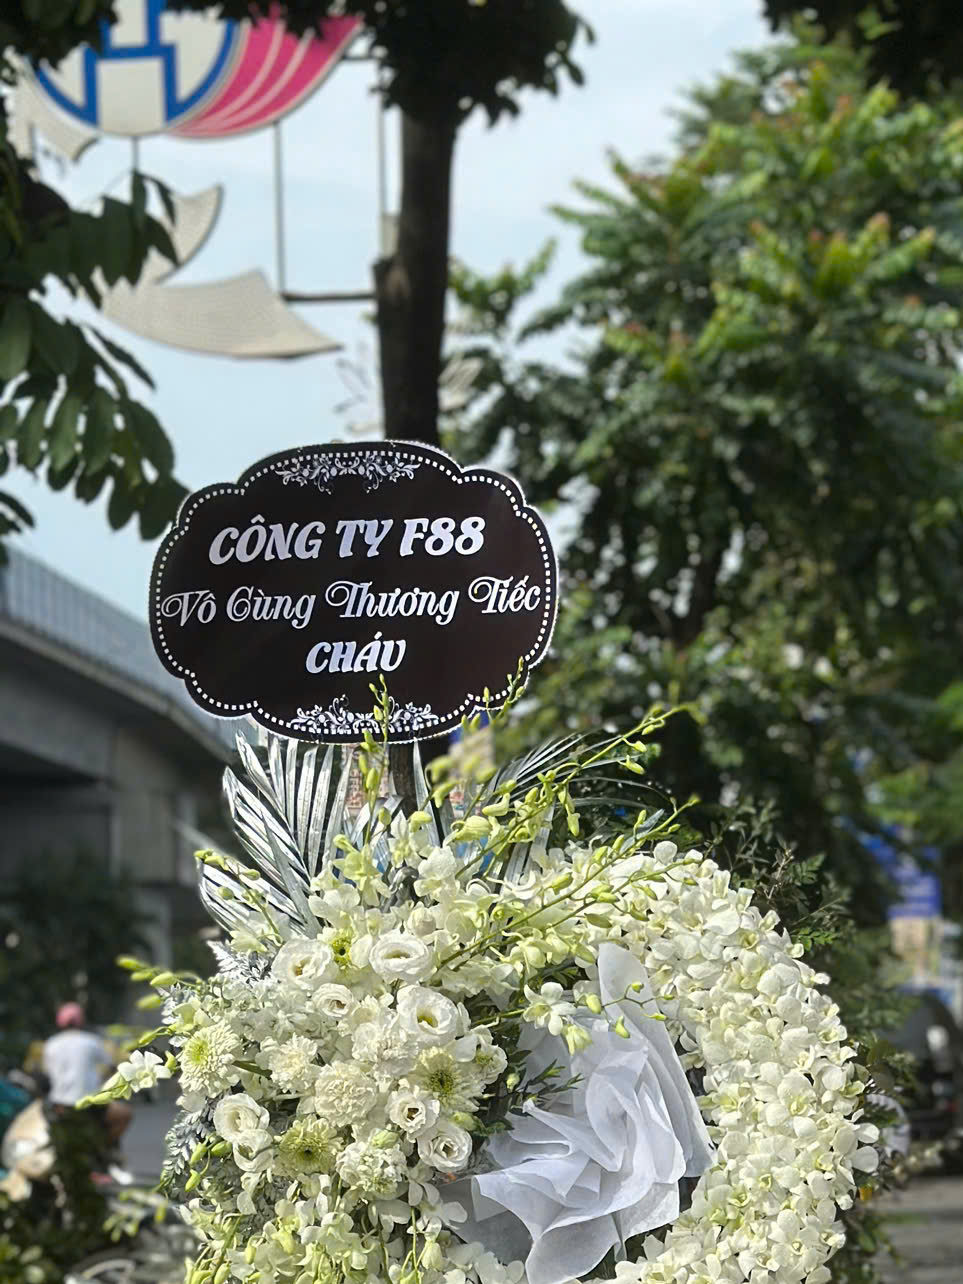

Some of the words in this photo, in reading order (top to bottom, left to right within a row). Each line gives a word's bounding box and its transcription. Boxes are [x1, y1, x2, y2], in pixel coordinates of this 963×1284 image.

[208, 514, 326, 566] CÔNG
[335, 518, 394, 558] TY
[399, 516, 486, 557] F88
[161, 589, 217, 627] Vô
[226, 585, 316, 629] Cùng
[326, 580, 460, 626] Thương
[468, 575, 541, 614] Tiếc
[306, 631, 406, 674] CHÁU
